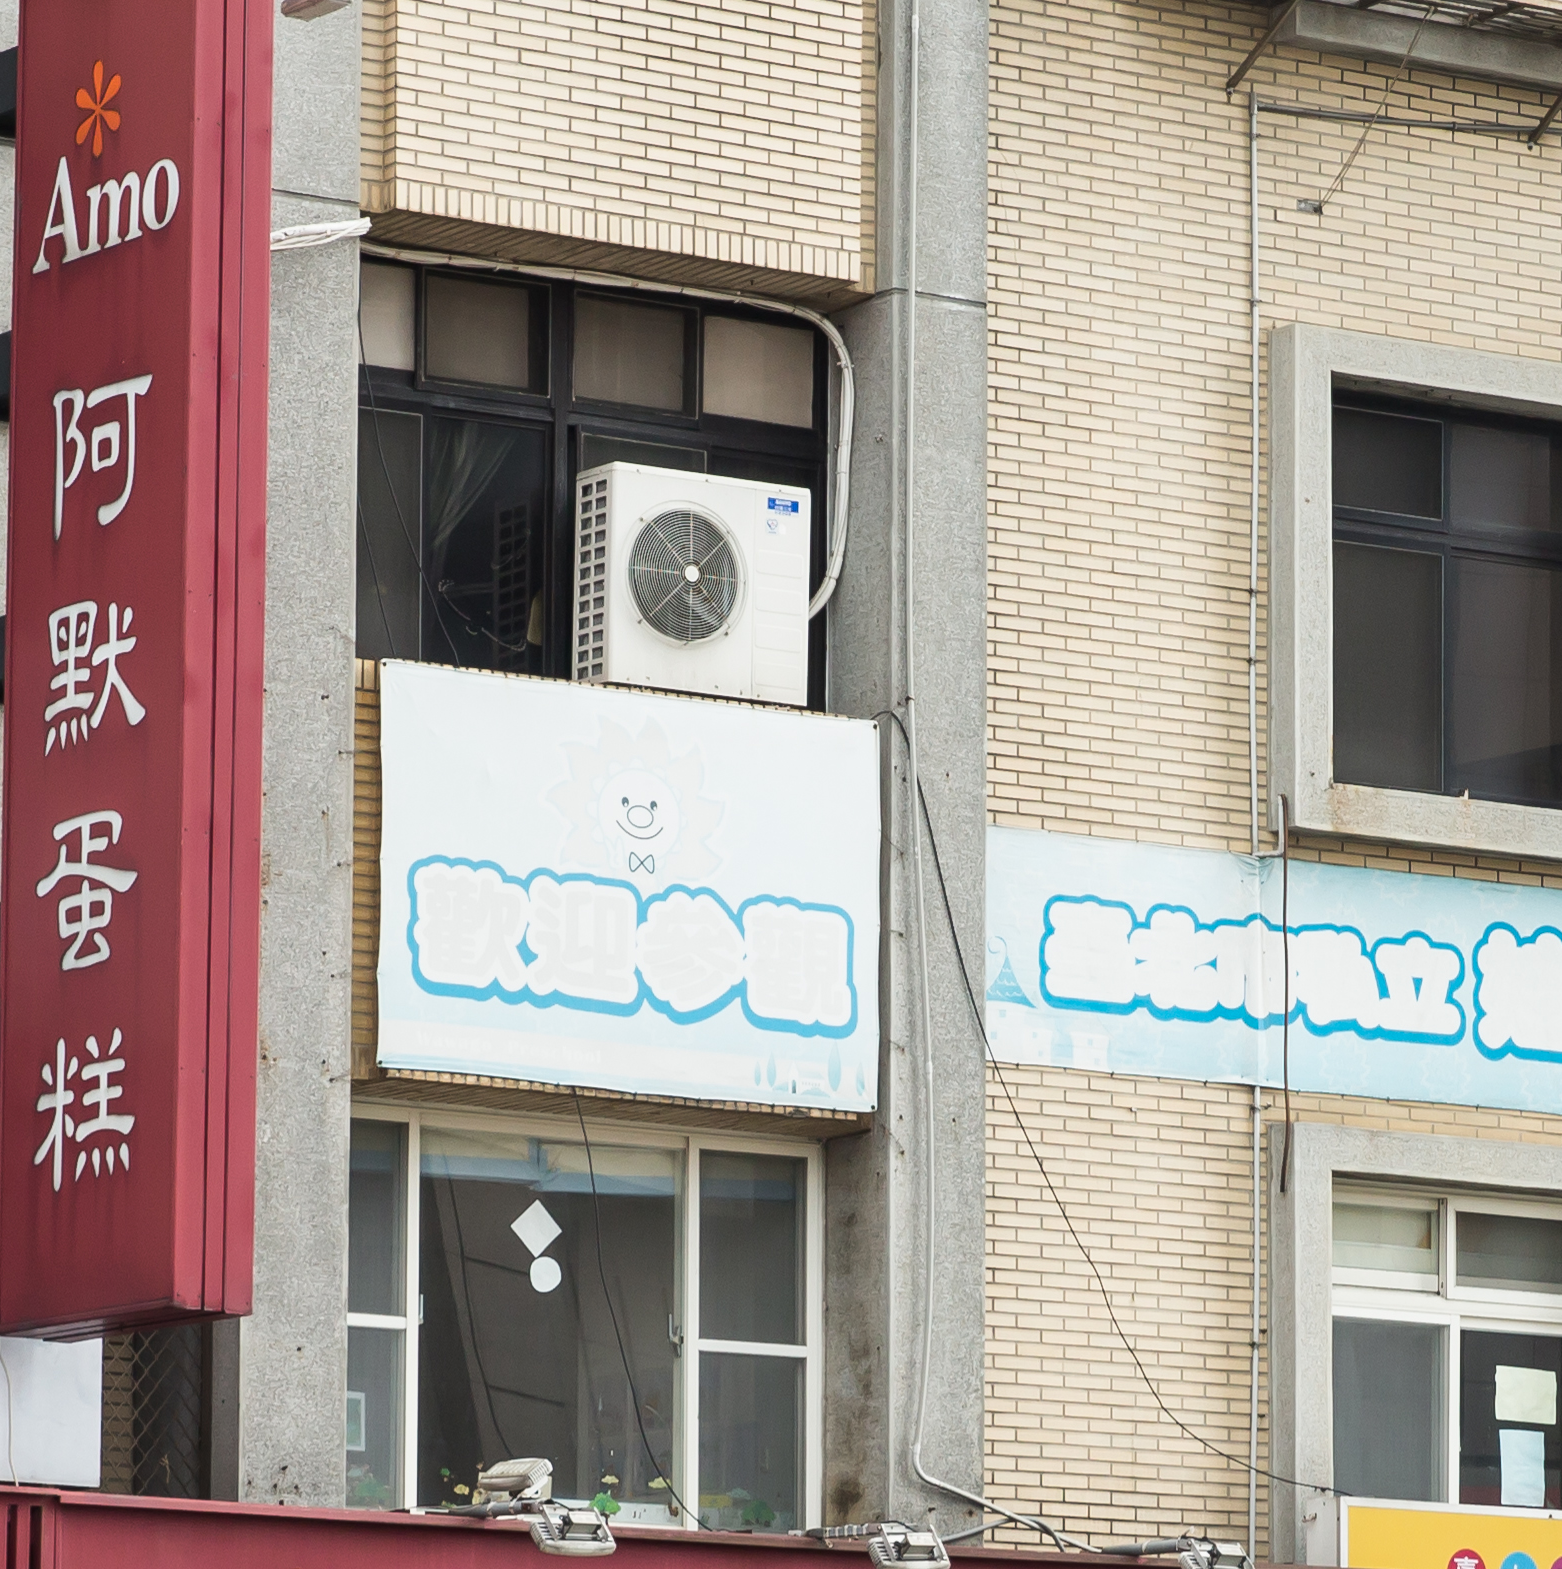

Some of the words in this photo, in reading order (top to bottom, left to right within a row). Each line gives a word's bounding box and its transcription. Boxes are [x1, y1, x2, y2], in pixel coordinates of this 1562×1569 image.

[32, 155, 181, 276] Amo
[35, 373, 154, 1193] 阿默蛋糕
